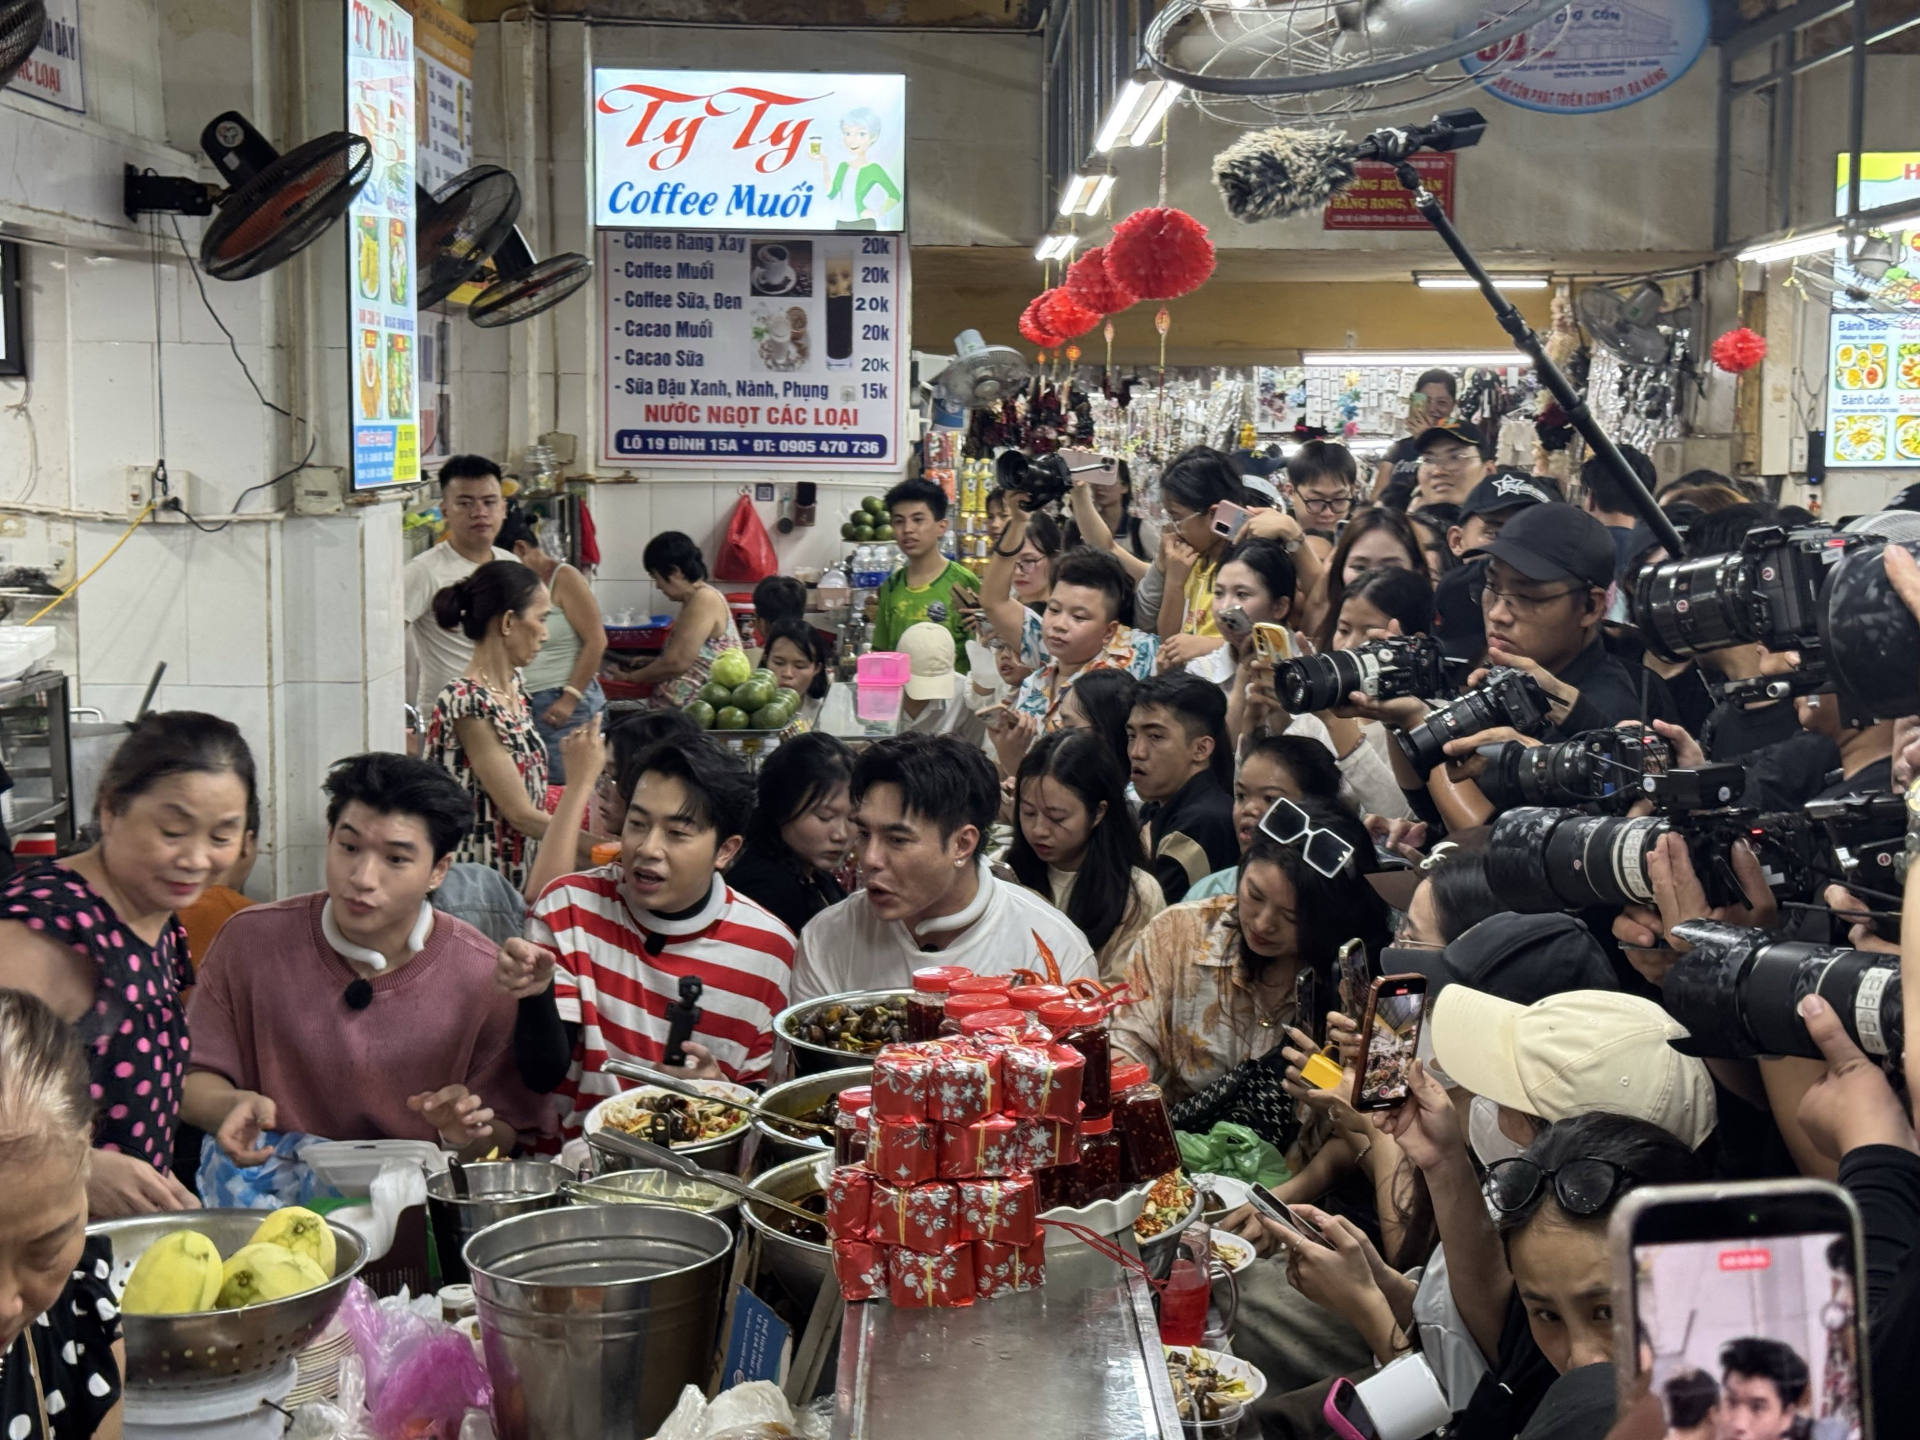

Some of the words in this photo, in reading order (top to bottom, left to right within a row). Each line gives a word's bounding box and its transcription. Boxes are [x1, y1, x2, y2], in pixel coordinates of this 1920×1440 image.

[597, 84, 714, 171] Ty
[705, 87, 834, 173] Ty
[608, 181, 719, 216] Coffee
[725, 180, 815, 217] Muối
[624, 232, 672, 249] Coffee
[676, 234, 714, 252] Rang
[718, 234, 747, 253] Xay
[861, 237, 890, 254] 20k
[624, 261, 672, 279] Coffee
[677, 260, 714, 280] Muối
[861, 267, 890, 284] 20k
[625, 290, 672, 308] Coffee
[676, 291, 710, 311] Sữa,
[713, 292, 742, 310] Đen
[625, 319, 672, 337] Cacao
[676, 318, 713, 338] Muối
[862, 324, 889, 341] 20k
[625, 348, 672, 366] Cacao
[676, 349, 704, 367] Sữa
[861, 358, 890, 372] 20k
[625, 377, 653, 395] Sữa
[657, 378, 686, 399] Đậu
[690, 379, 732, 398] Xanh,
[736, 380, 779, 399] Nành,
[783, 381, 829, 402] Phụng
[861, 382, 888, 399] 15k
[645, 401, 701, 423] NƯỚC
[707, 405, 760, 428] NGỌT
[766, 403, 807, 425] CÁC
[814, 407, 858, 430] LOẠI
[646, 437, 665, 450] 19
[668, 435, 706, 451] ĐÌNH
[710, 438, 738, 452] 15A
[753, 439, 776, 452] ĐT:
[779, 440, 816, 453] 0905
[819, 441, 848, 453] 470
[851, 441, 880, 454] 736
